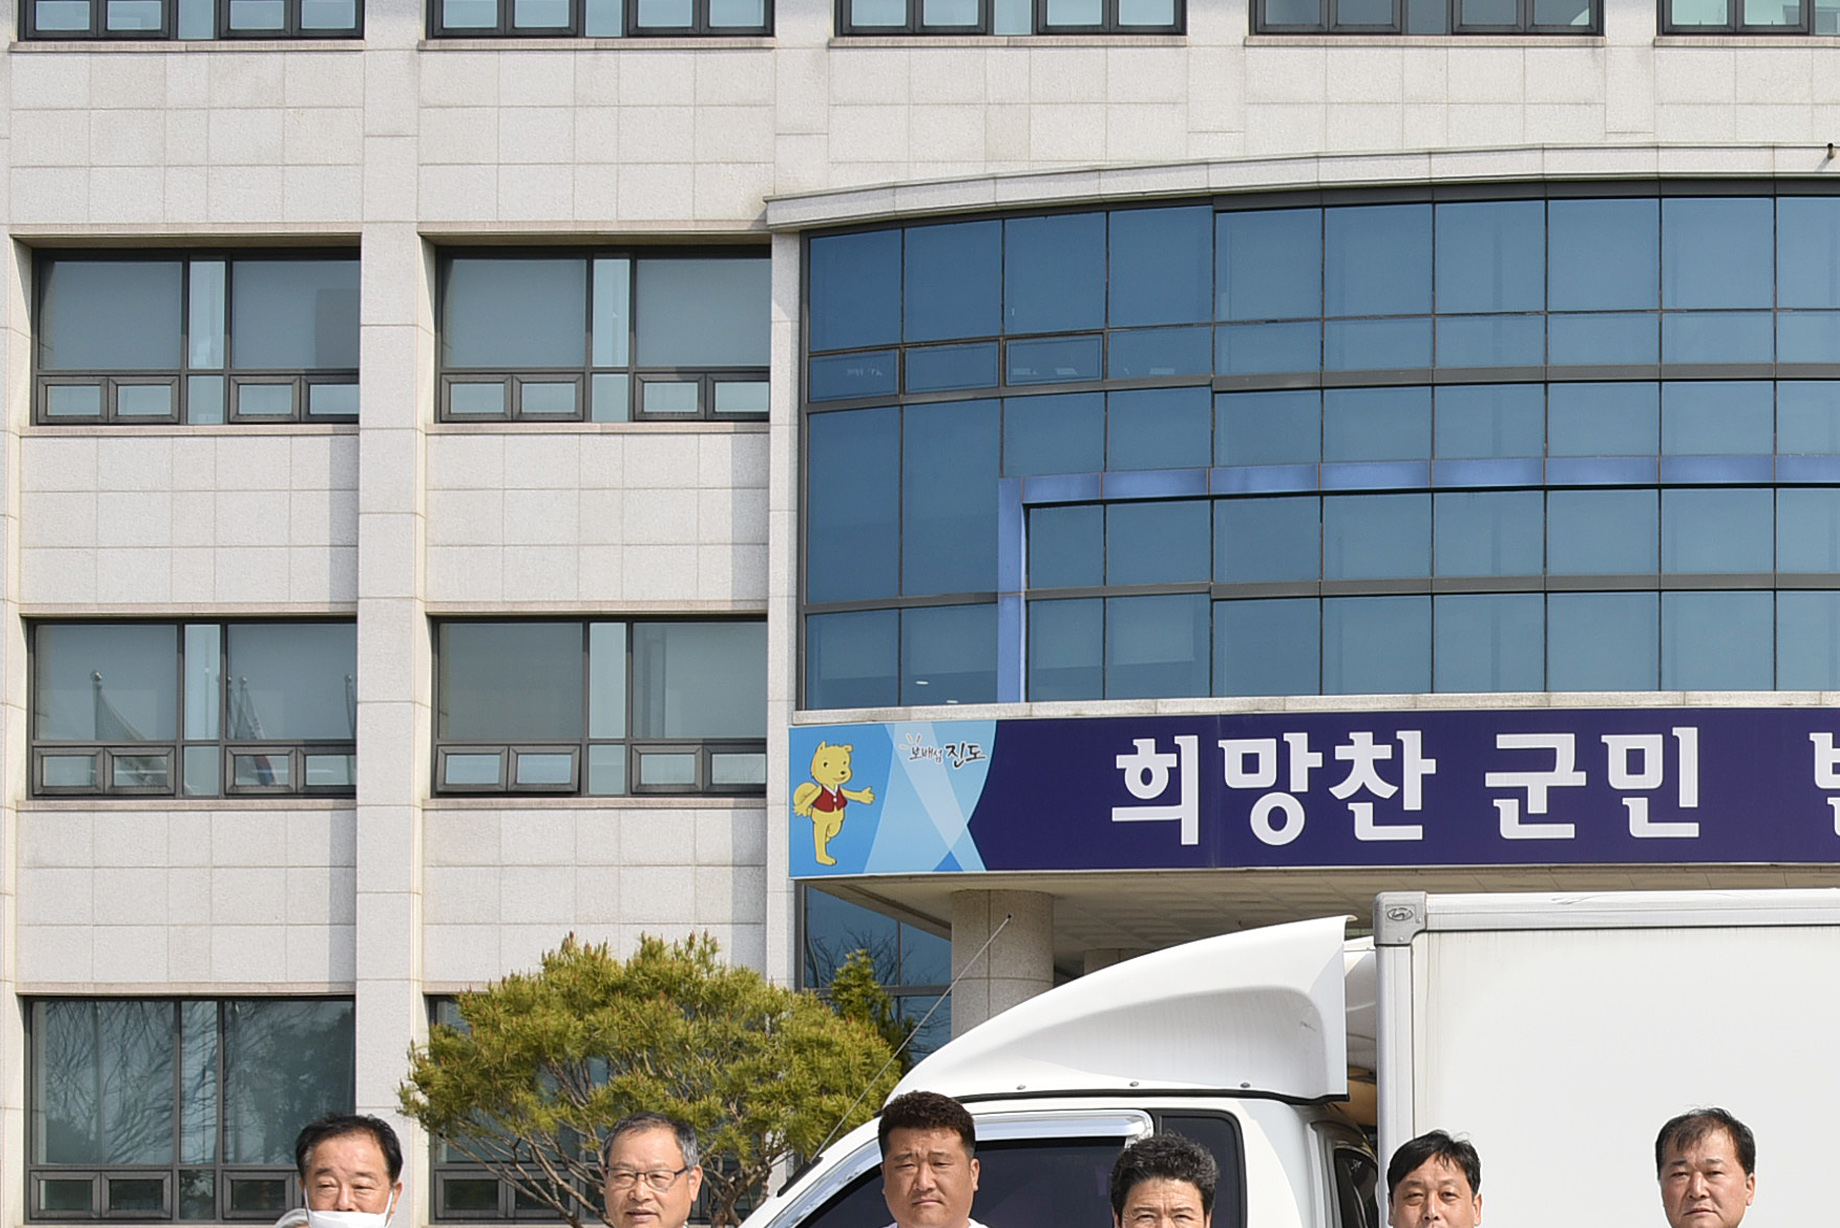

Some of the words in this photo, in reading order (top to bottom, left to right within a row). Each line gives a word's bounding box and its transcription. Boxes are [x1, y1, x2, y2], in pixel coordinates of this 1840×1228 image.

[946, 742, 987, 768] 진도
[1112, 731, 1436, 845] 희망찬
[1485, 728, 1699, 839] 군민
